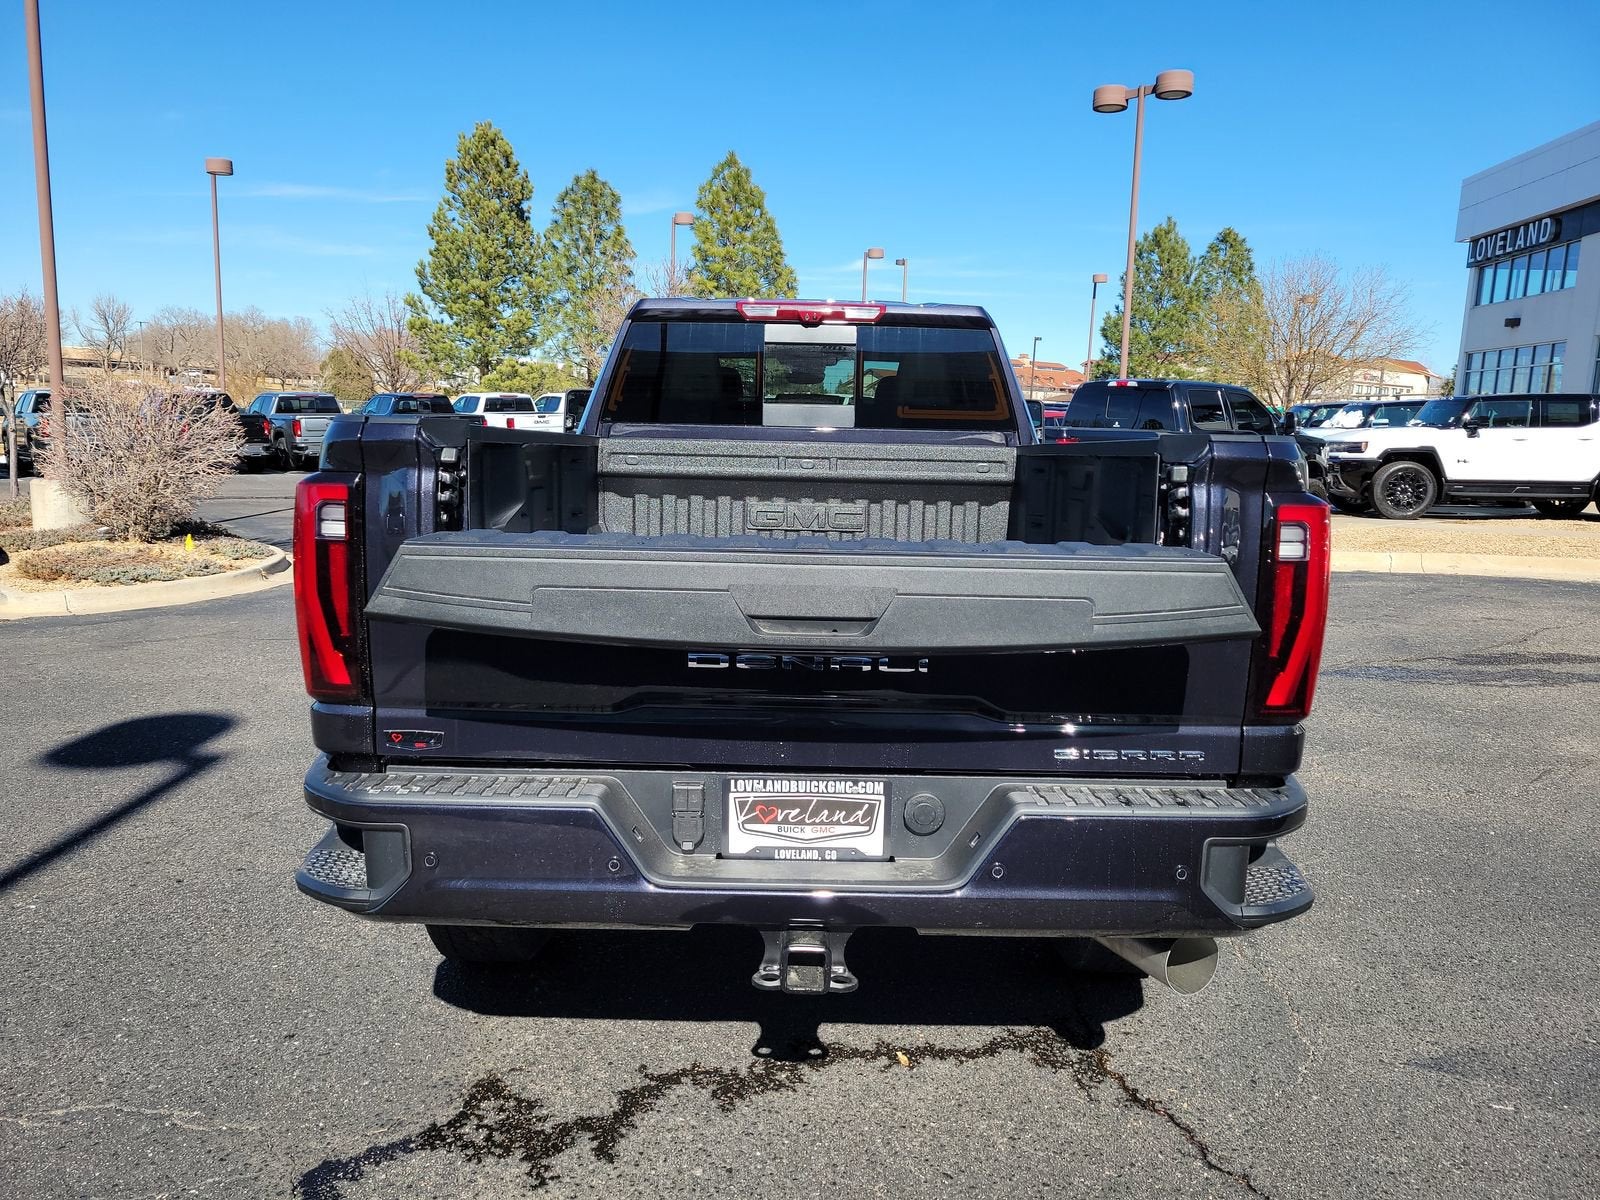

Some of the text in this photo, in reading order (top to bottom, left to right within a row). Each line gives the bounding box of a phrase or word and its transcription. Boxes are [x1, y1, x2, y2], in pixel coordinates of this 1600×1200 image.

[1468, 217, 1552, 263] LOVELAND
[749, 504, 863, 529] GMC
[687, 653, 929, 673] DENALI
[1053, 749, 1205, 761] SIERRA
[730, 779, 884, 795] LOVELANDBUICKGMC.COM
[777, 826, 836, 834] BUICK GMC
[774, 849, 837, 861] LOVELAND, CO
